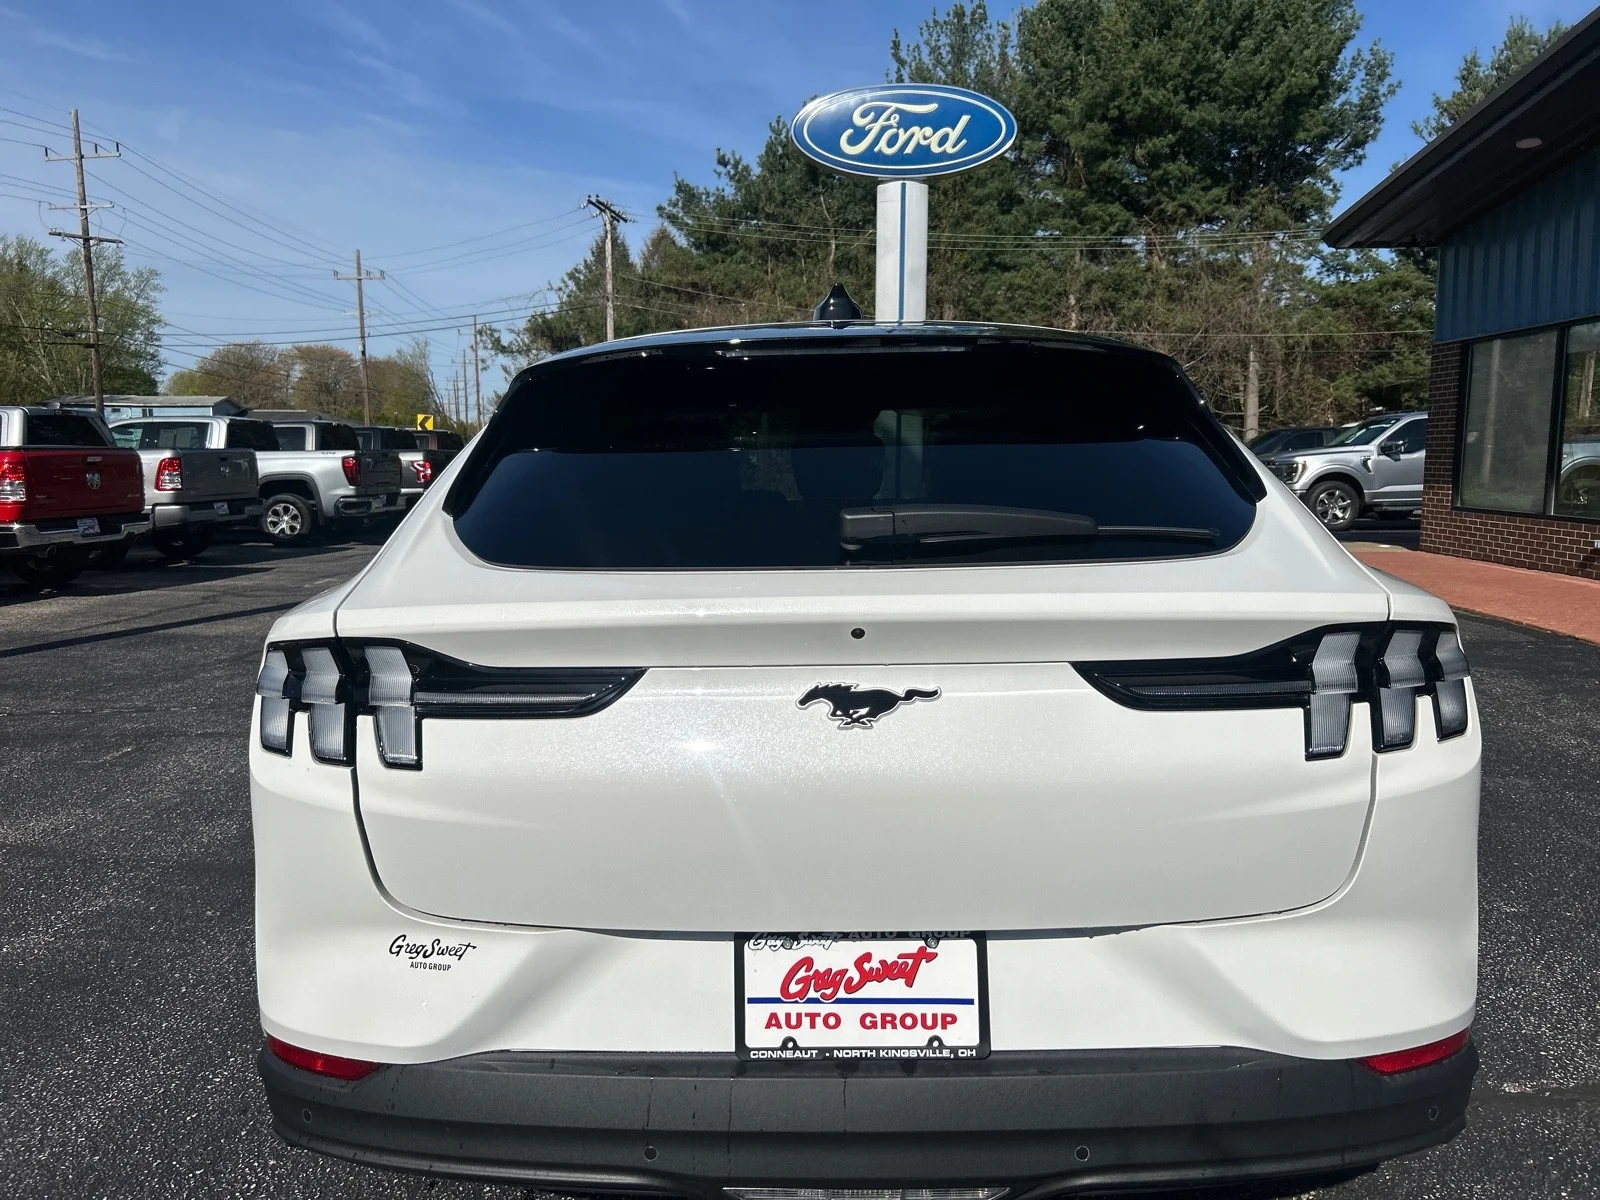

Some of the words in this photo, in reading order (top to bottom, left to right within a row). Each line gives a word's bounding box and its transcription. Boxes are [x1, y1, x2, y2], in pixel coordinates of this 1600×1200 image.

[840, 101, 971, 155] Ford
[388, 934, 427, 960] Greg
[422, 938, 478, 961] Sweet
[409, 961, 428, 970] AUTO
[428, 962, 452, 972] GROUP
[779, 956, 850, 1001] Greg
[844, 945, 939, 995] Sweet
[764, 1012, 842, 1030] AUTO
[859, 1012, 958, 1030] GROUP
[749, 1049, 819, 1059] CONNEAUT
[833, 1049, 877, 1058] NORTH
[879, 1048, 955, 1059] KINGSVILLE,
[957, 1048, 977, 1058] OH
